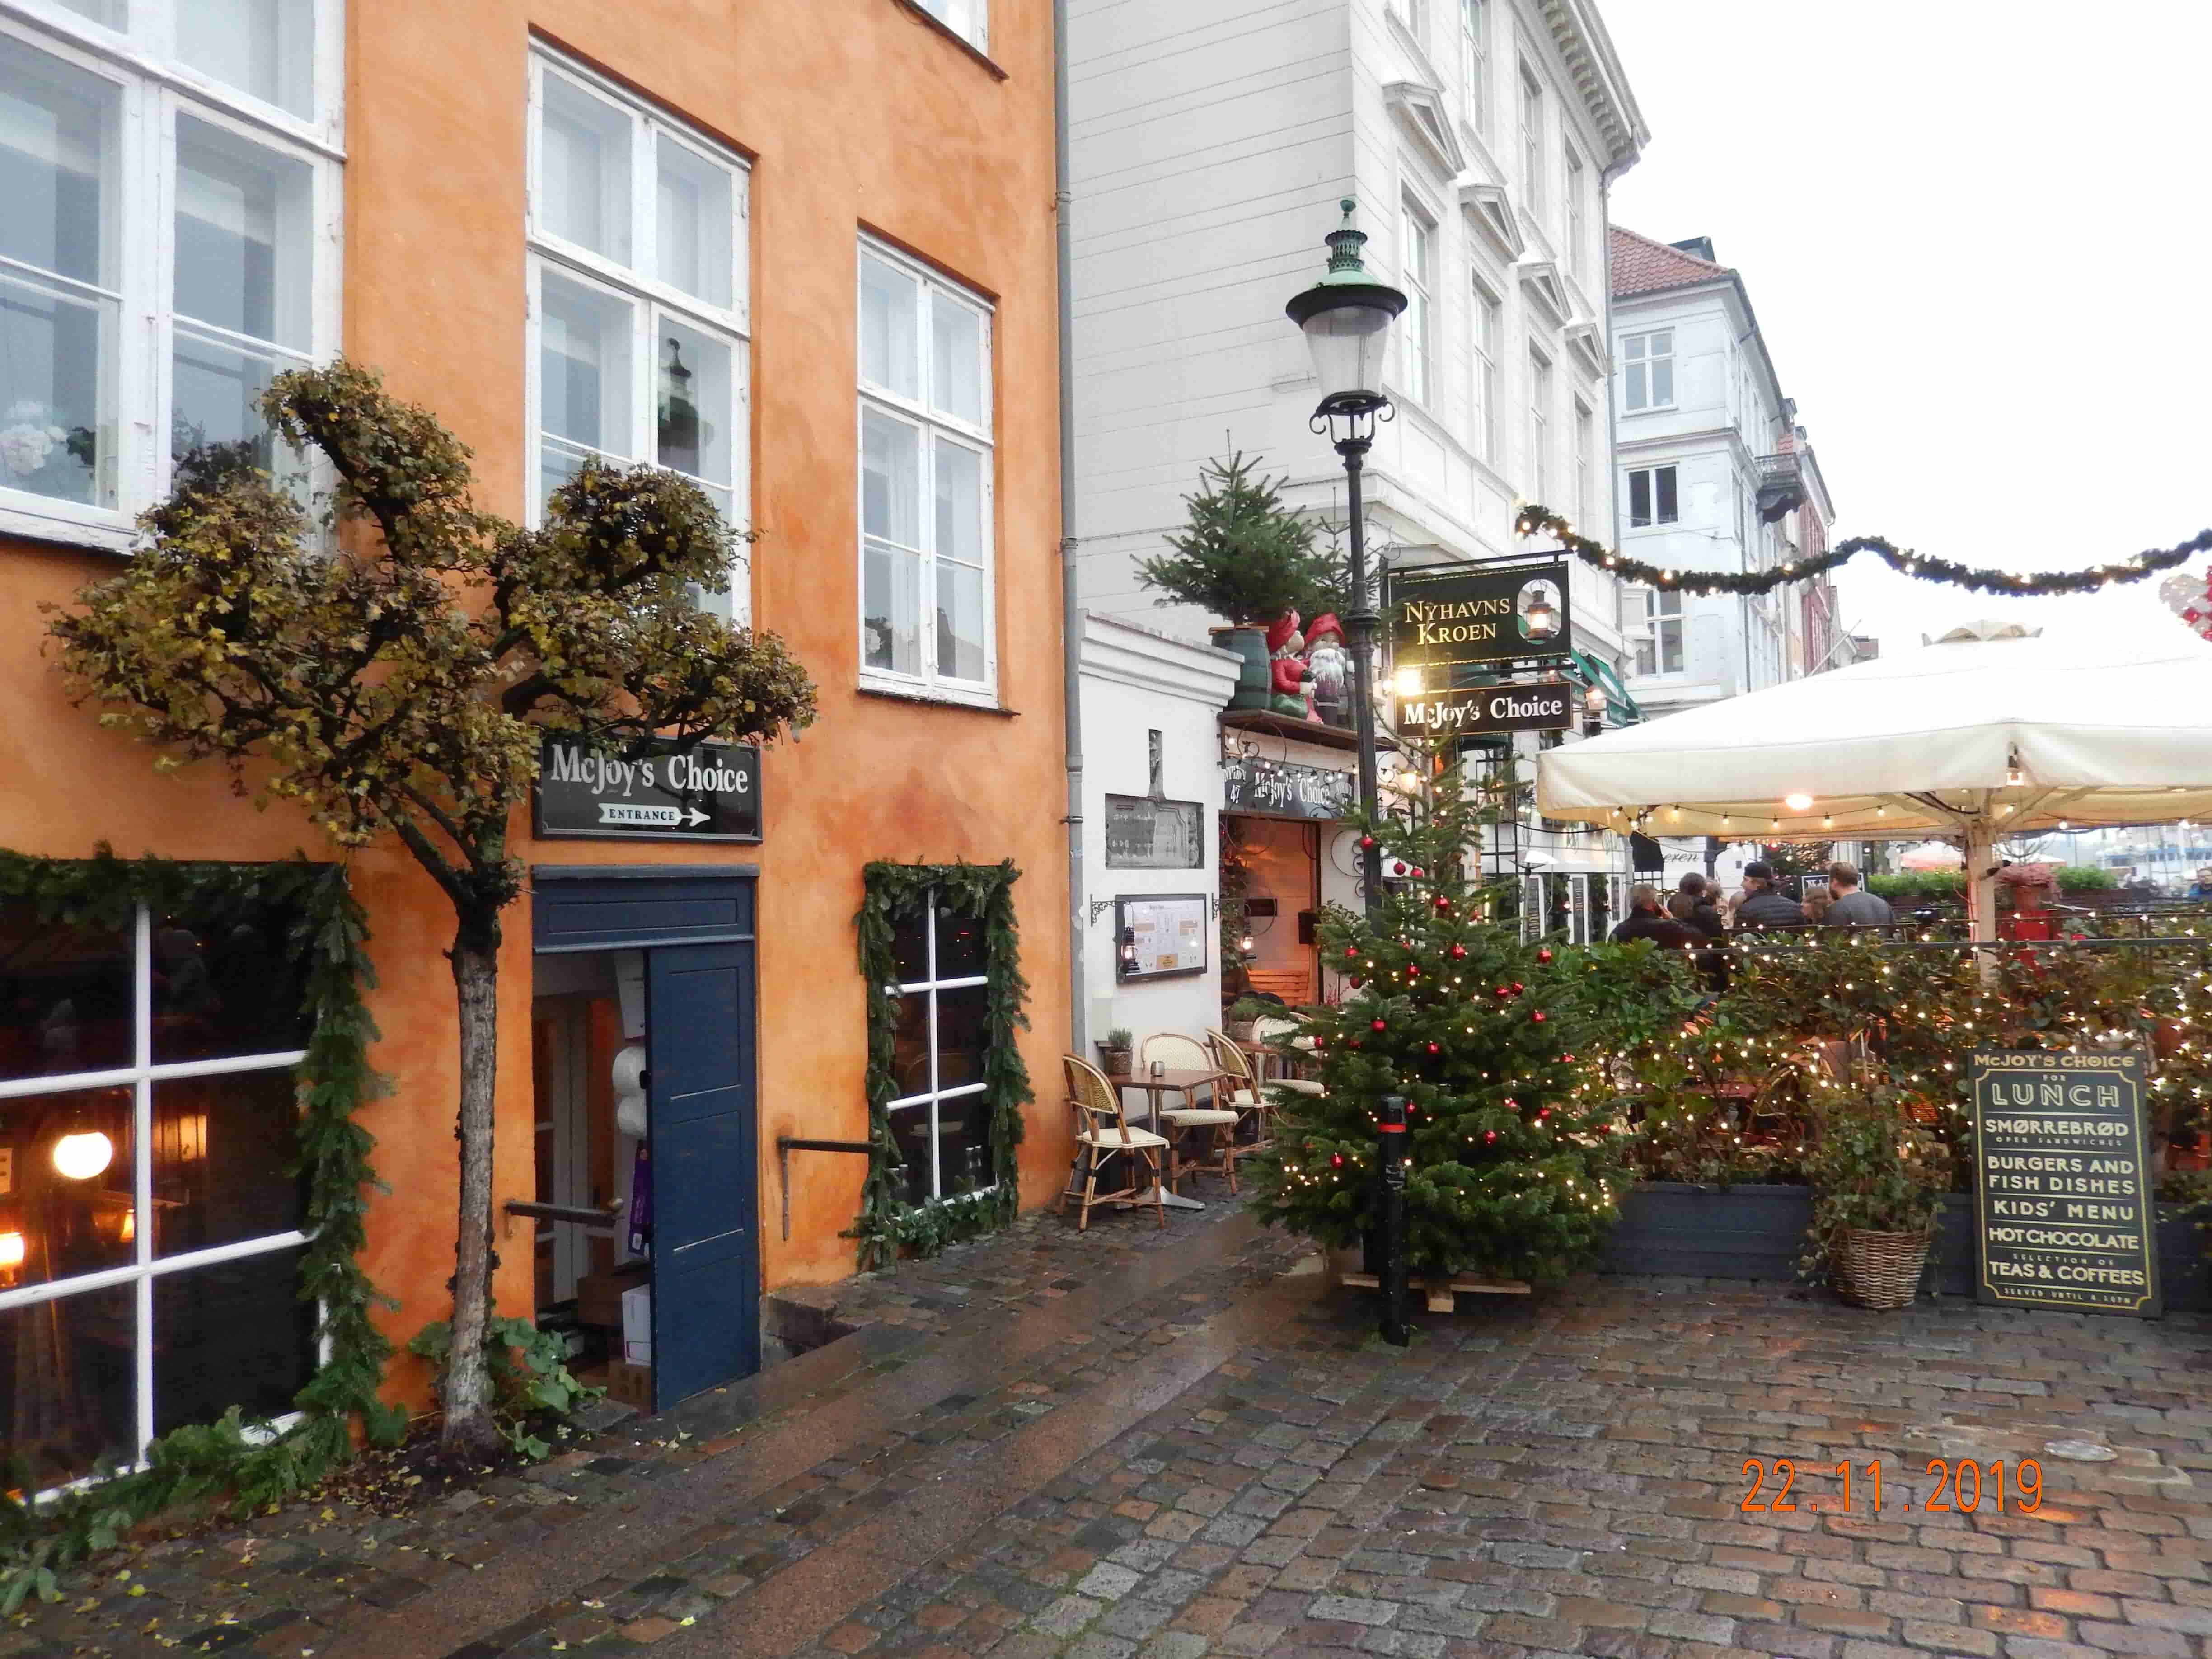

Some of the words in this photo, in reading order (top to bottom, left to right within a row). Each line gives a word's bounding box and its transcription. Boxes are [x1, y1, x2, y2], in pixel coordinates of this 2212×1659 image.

[1404, 598, 1511, 623] NYHAVNS
[1417, 623, 1496, 646] KROEN
[1403, 699, 1481, 729] McJoy's
[1490, 695, 1563, 719] Choice
[550, 744, 655, 797] McJoy's
[668, 755, 749, 793] Choice
[1299, 777, 1331, 804] Choice
[609, 808, 675, 821] ENTRANCE
[2060, 1056, 2136, 1067] CHOICE
[1991, 1083, 2120, 1107] LUNCH
[1985, 1119, 2129, 1137] SMØRREBRØD
[2038, 1137, 2122, 1146] SANDWICHES
[1987, 1155, 2083, 1172] BURGERS
[2089, 1159, 2135, 1174] AND
[1988, 1174, 2039, 1190] FISH
[2049, 1176, 2135, 1195] DISHES
[1993, 1200, 2056, 1217] KIDS'
[2067, 1204, 2134, 1220] MENU
[1988, 1227, 2025, 1242] HOT
[2026, 1229, 2139, 1250] CHOCOLATE
[2013, 1253, 2088, 1264] SELECTION
[1988, 1261, 2034, 1278] TEAS
[2038, 1265, 2053, 1279] &
[2057, 1265, 2145, 1286] COFFEES
